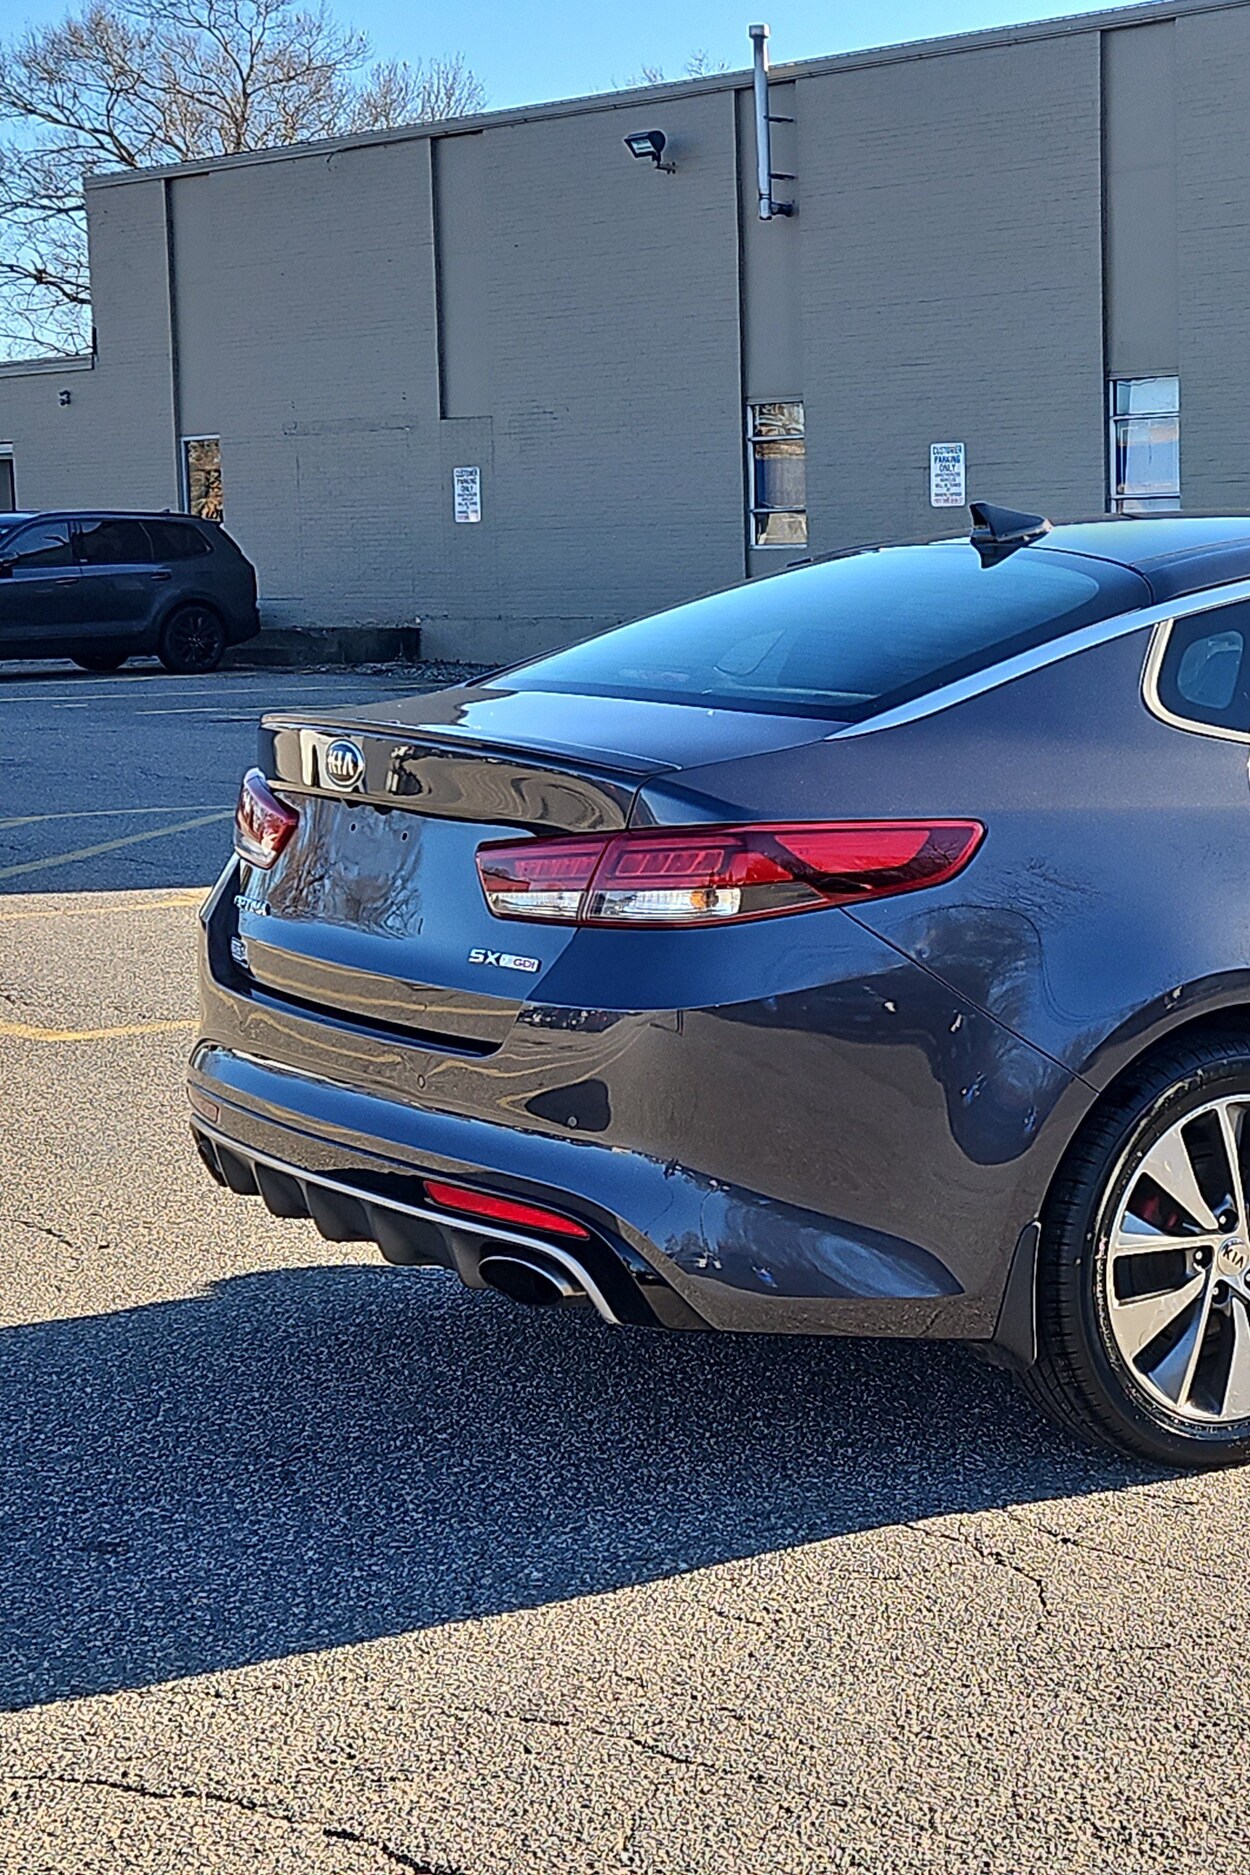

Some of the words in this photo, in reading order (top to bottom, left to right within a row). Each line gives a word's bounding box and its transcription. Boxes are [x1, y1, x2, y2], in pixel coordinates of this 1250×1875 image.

[934, 455, 961, 464] PARKING
[939, 463, 957, 472] ONLY
[1222, 1247, 1245, 1269] KIA
